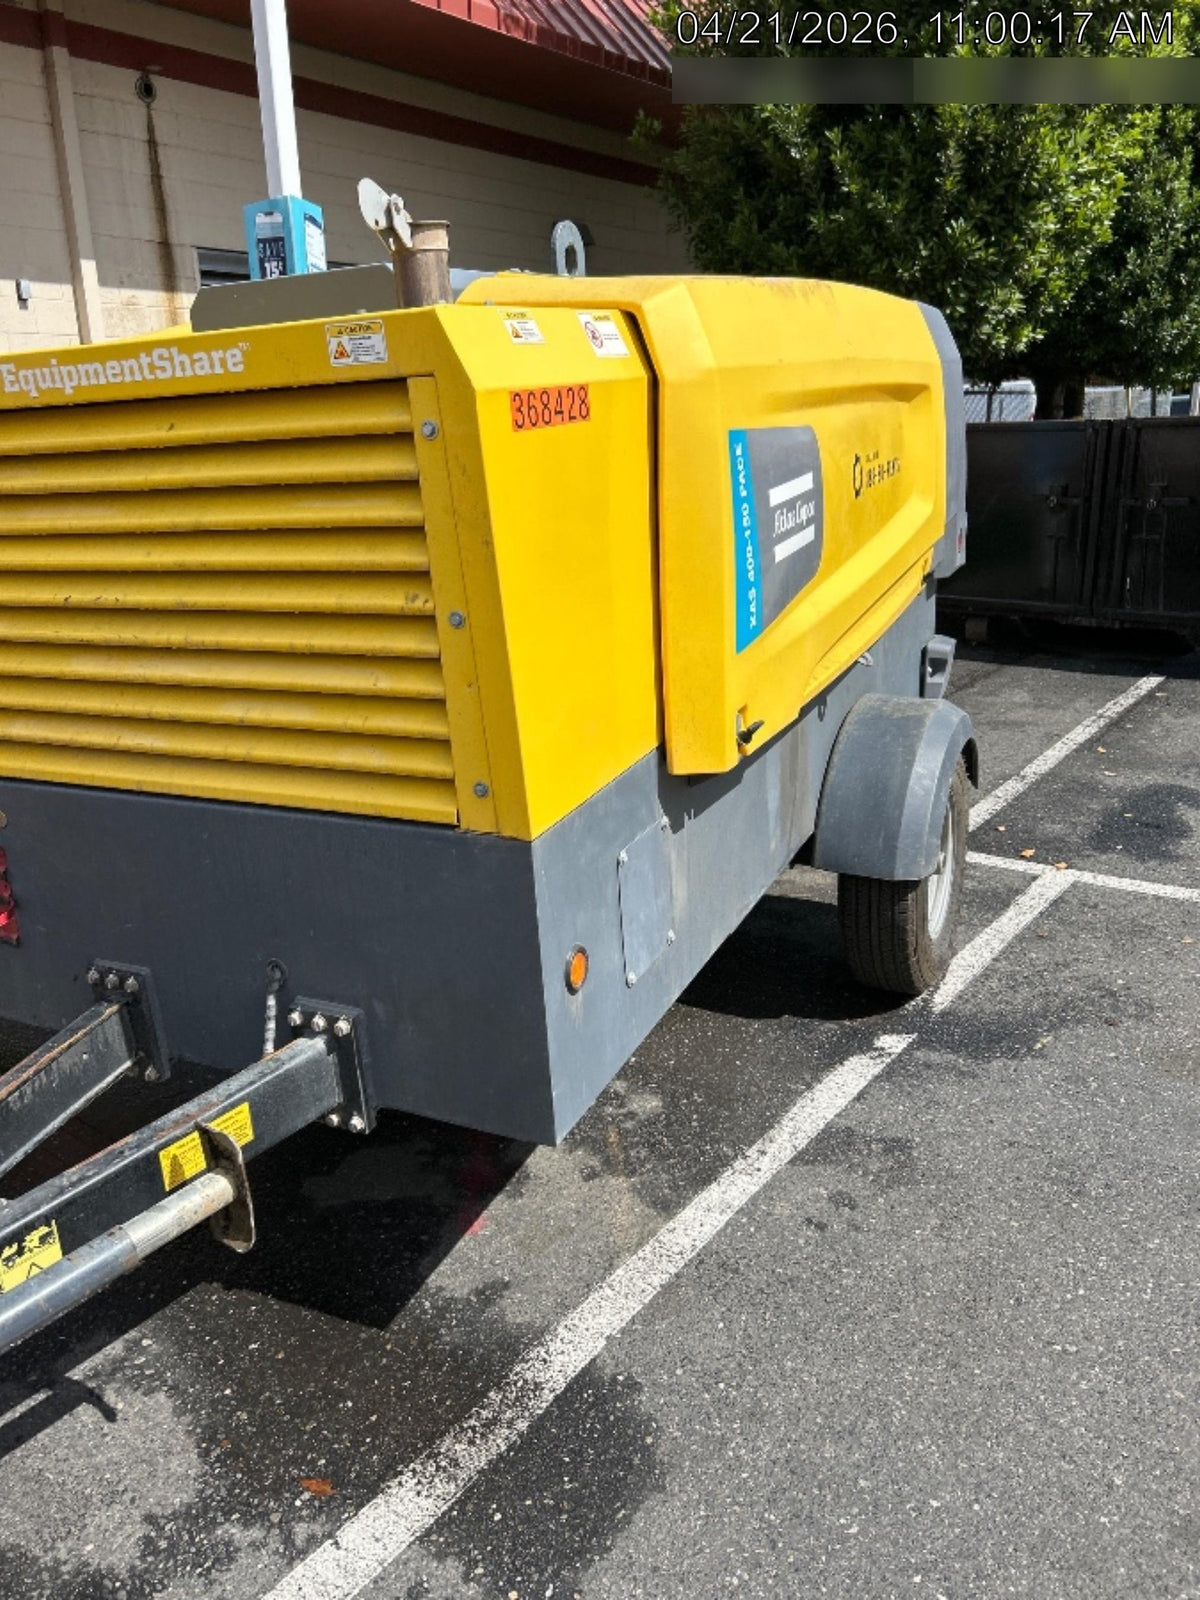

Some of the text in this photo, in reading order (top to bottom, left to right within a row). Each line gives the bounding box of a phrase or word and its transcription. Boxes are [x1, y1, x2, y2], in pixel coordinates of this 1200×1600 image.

[0, 347, 245, 398] EquipmentShare
[512, 386, 590, 429] 368428
[734, 442, 748, 497] PACE
